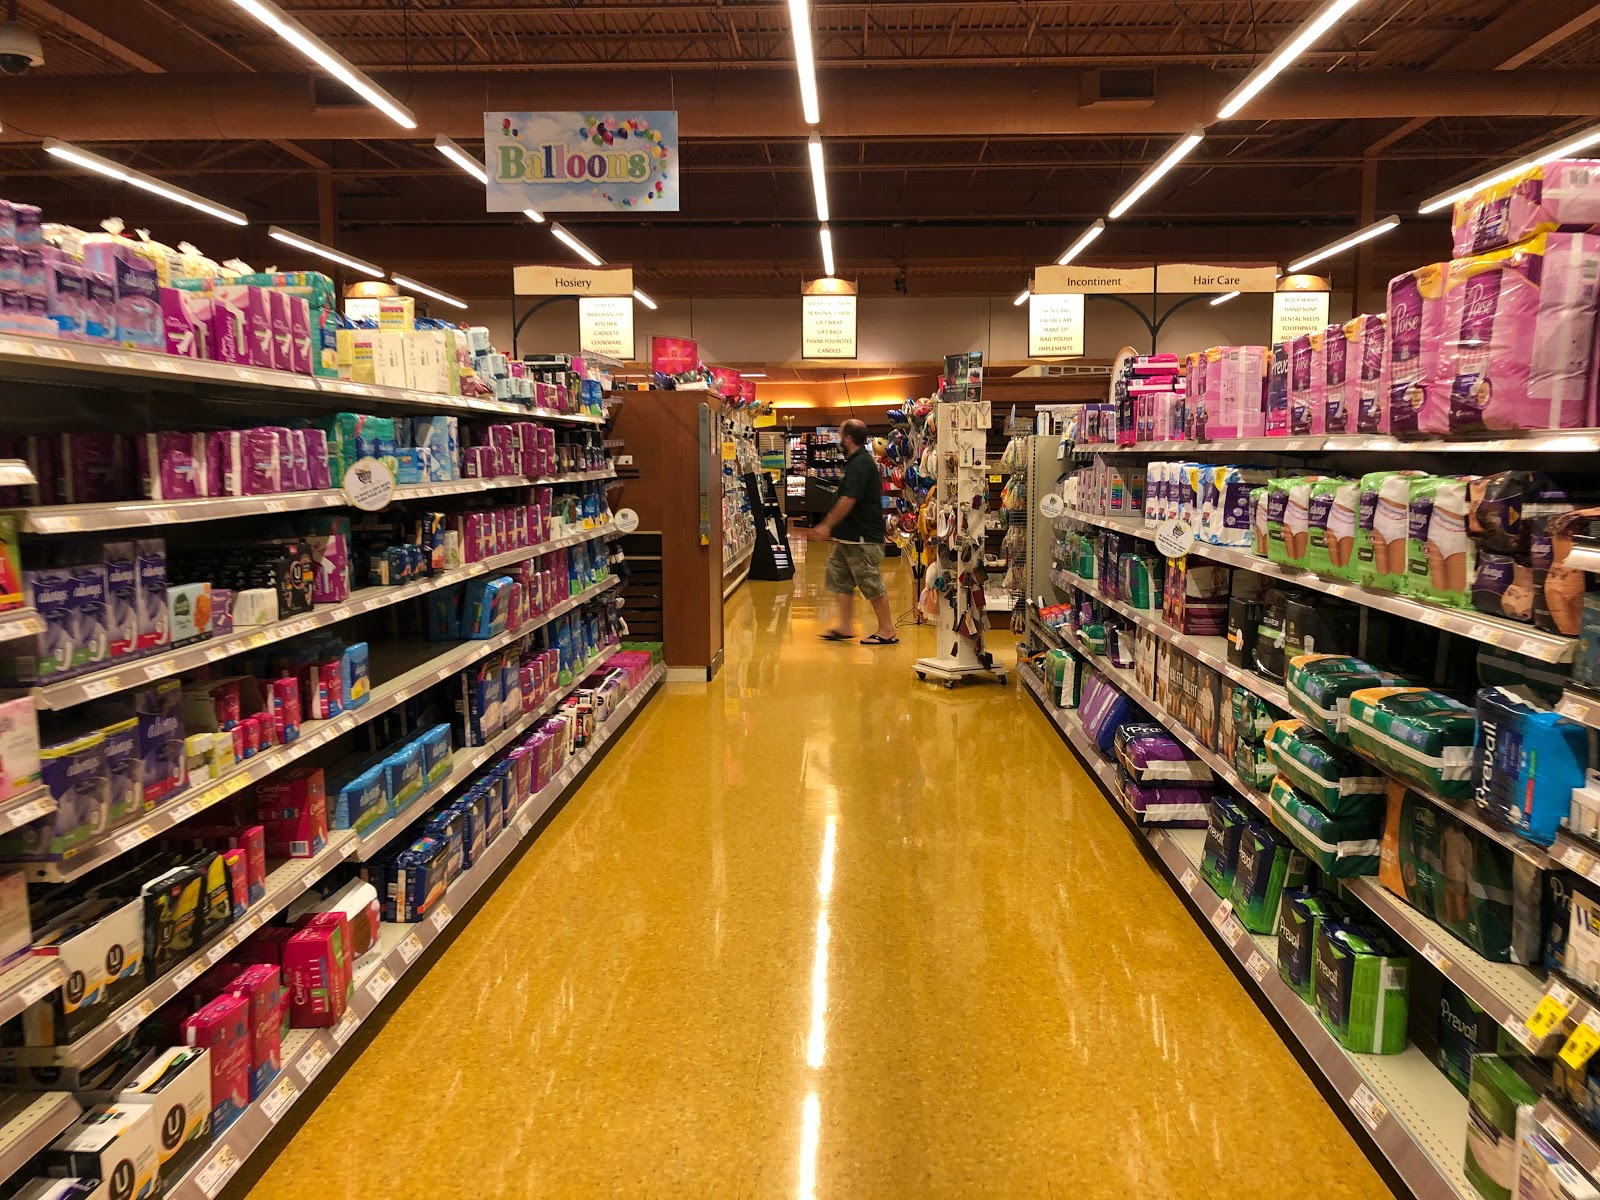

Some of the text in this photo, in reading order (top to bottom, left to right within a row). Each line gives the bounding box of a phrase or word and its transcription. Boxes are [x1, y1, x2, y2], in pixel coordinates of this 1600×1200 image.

[498, 144, 648, 181] Balloons
[555, 277, 592, 290] Hosiery
[1067, 276, 1122, 287] Incontinent
[1193, 275, 1240, 286] Hair Care
[1466, 283, 1493, 322] Poise
[1392, 303, 1419, 337] Poise
[1294, 347, 1310, 373] Poise
[1327, 341, 1344, 366] Poise
[1268, 499, 1284, 516] always
[1310, 501, 1326, 518] always
[109, 569, 134, 584] always
[1482, 565, 1505, 580] always
[38, 588, 69, 605] always
[73, 583, 103, 599] always
[104, 739, 134, 758] always
[66, 756, 100, 777] always
[402, 761, 419, 781] always
[1475, 720, 1497, 810] Prevail
[256, 784, 290, 794] Carefree
[360, 784, 381, 807] always
[1208, 816, 1225, 847] Prevail
[1238, 840, 1255, 872] Prevail
[1280, 916, 1300, 951] Prevail
[109, 948, 122, 966] U
[1316, 948, 1338, 988] Prevail
[70, 974, 82, 994] U
[1440, 998, 1478, 1044] Prevail
[168, 1109, 180, 1136] U
[114, 1164, 129, 1194] U
